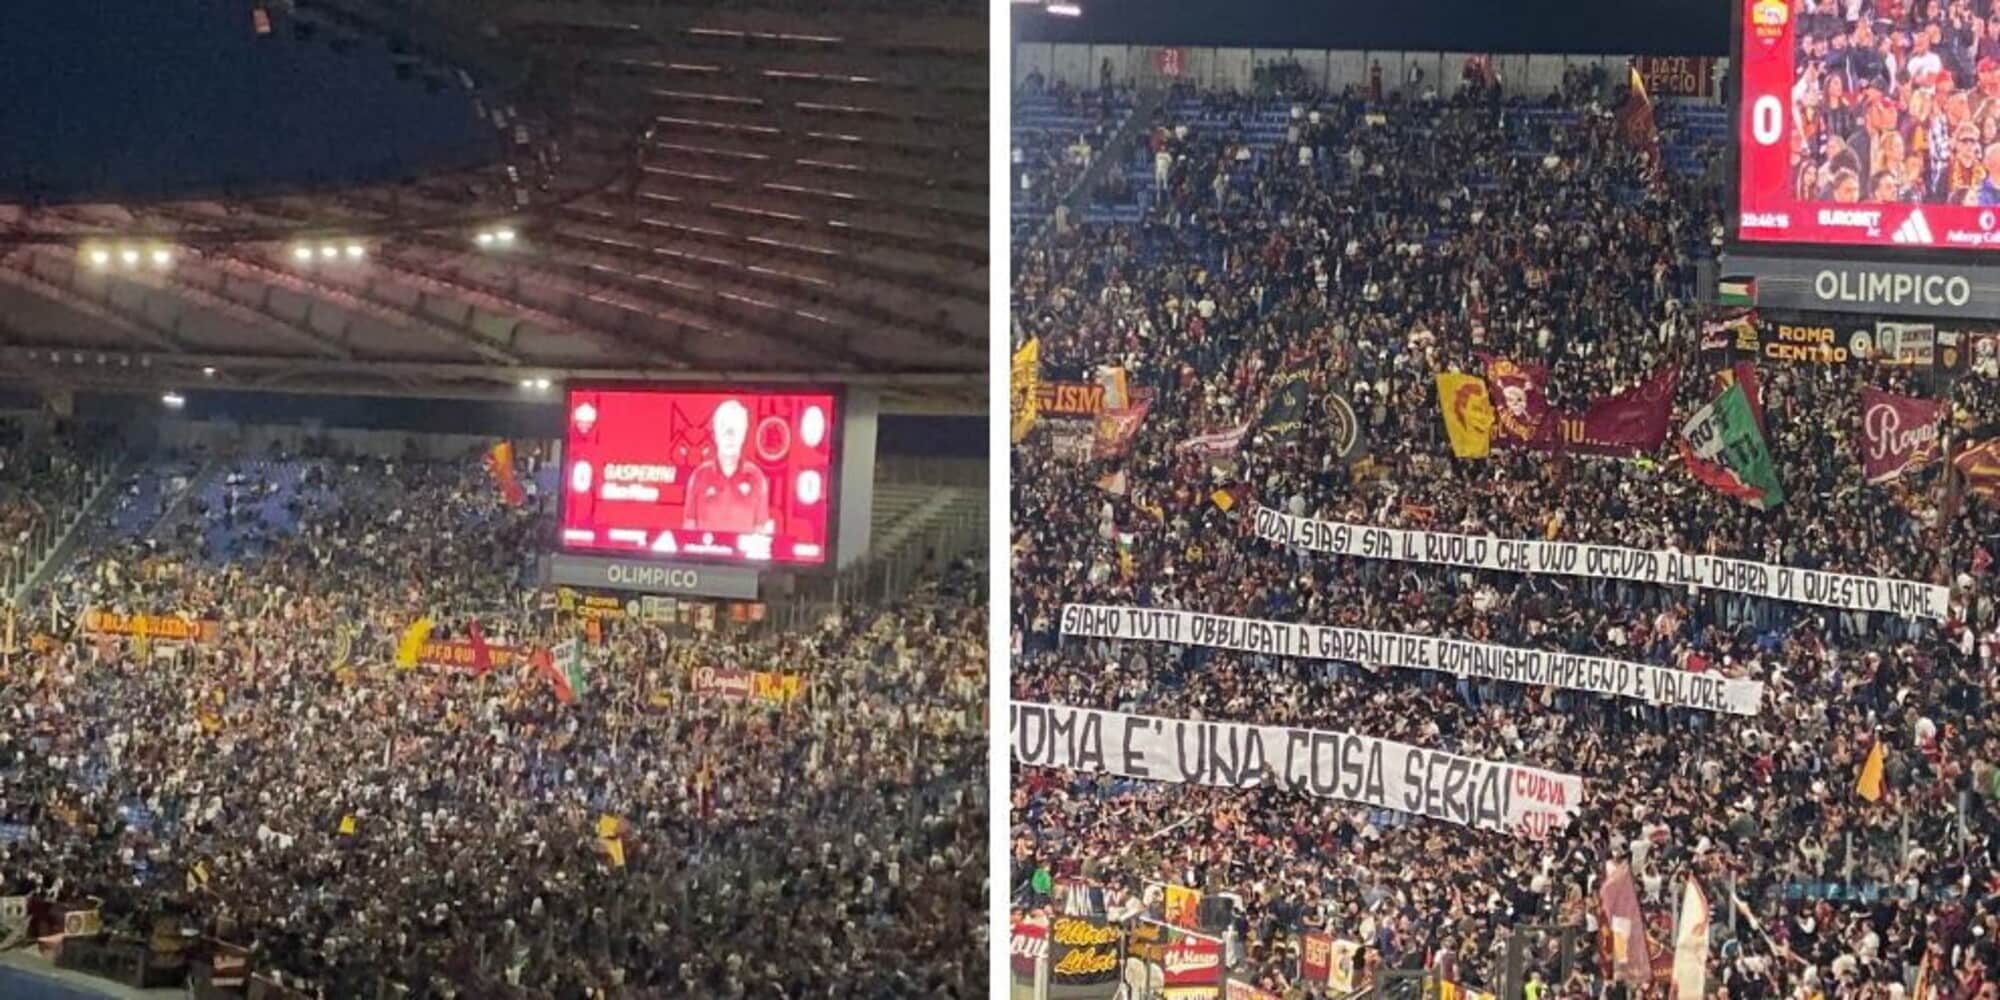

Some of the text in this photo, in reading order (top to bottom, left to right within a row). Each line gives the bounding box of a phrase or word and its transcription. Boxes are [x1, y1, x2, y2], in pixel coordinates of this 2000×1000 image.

[1753, 96, 1782, 146] 0
[1815, 270, 1970, 306] OLIMPICO
[1778, 325, 1836, 343] ROMA
[607, 565, 698, 588] OLIMPICO
[1257, 509, 1352, 551] QUALSIASI
[1363, 531, 1393, 556] SIA
[1403, 533, 1418, 560] IL
[1425, 534, 1487, 565] RUOLO
[1497, 541, 1530, 570] CHE
[1539, 543, 1576, 572] UNO
[1587, 546, 1657, 579] OCCUPA
[1778, 571, 1794, 597] DI
[1804, 573, 1878, 608] QUESTO
[1063, 605, 1120, 635] SIAMO
[1127, 610, 1179, 641] TUTTI
[1192, 615, 1289, 653] OBBLIGATI
[1299, 630, 1310, 655] A
[1319, 629, 1429, 667] GARANTIRE
[1635, 668, 1645, 695] E
[1123, 715, 1163, 776] E'
[1177, 721, 1265, 785] UNA
[1285, 730, 1384, 804] COSA
[1515, 769, 1566, 808] CURVA
